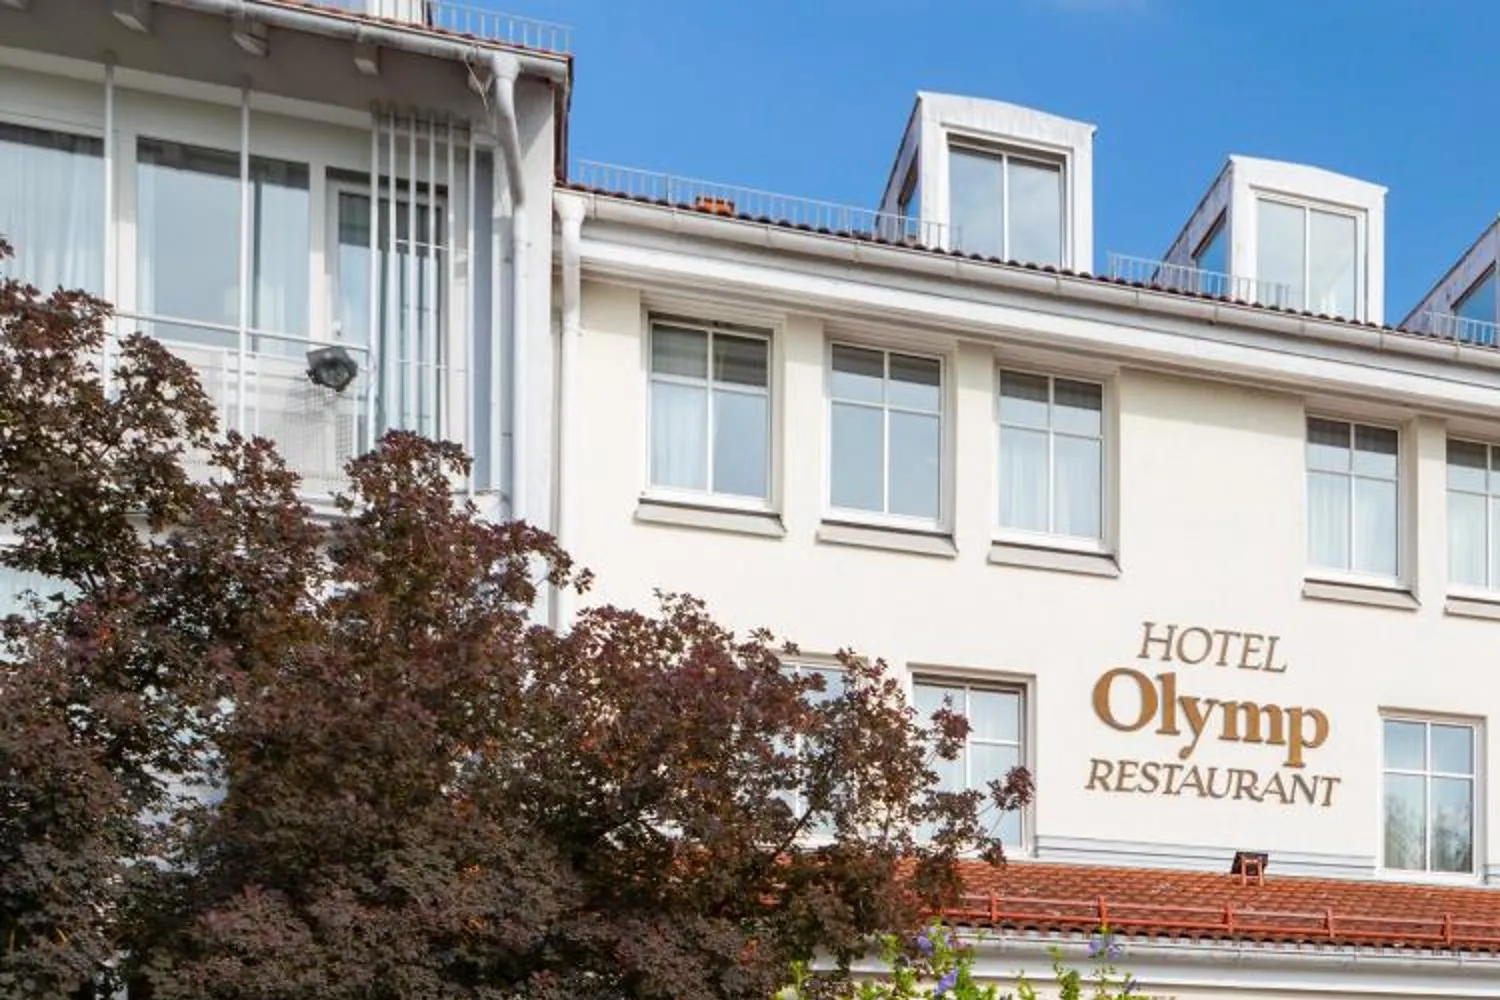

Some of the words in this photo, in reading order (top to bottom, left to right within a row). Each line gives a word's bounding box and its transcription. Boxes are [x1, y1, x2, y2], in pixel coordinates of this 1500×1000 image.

[1137, 621, 1287, 673] HOTEL
[1091, 667, 1329, 768] Olymp
[1085, 758, 1341, 807] RESTAURANT
